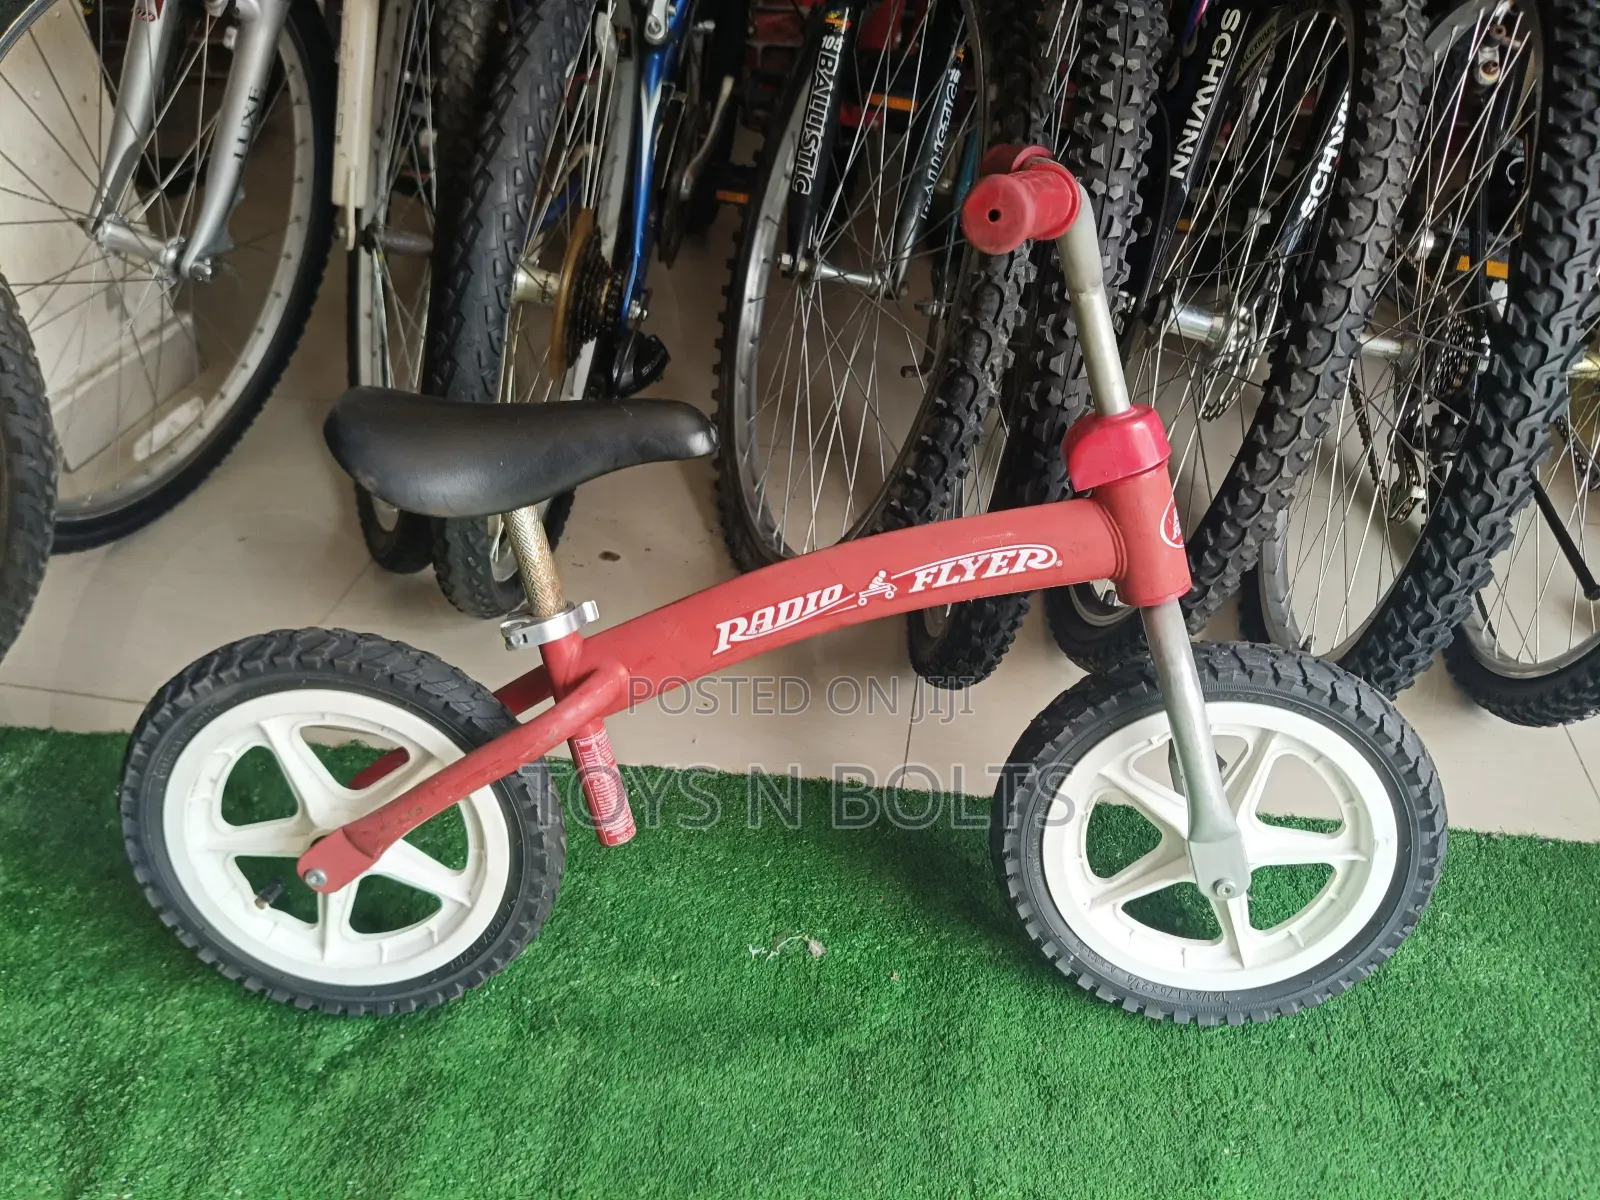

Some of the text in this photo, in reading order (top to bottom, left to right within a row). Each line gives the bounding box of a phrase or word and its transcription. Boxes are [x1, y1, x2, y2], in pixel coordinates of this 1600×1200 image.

[792, 51, 839, 195] BALLISTIC
[1169, 8, 1241, 179] SCHWINN
[712, 546, 1058, 656] RADIO FLYER
